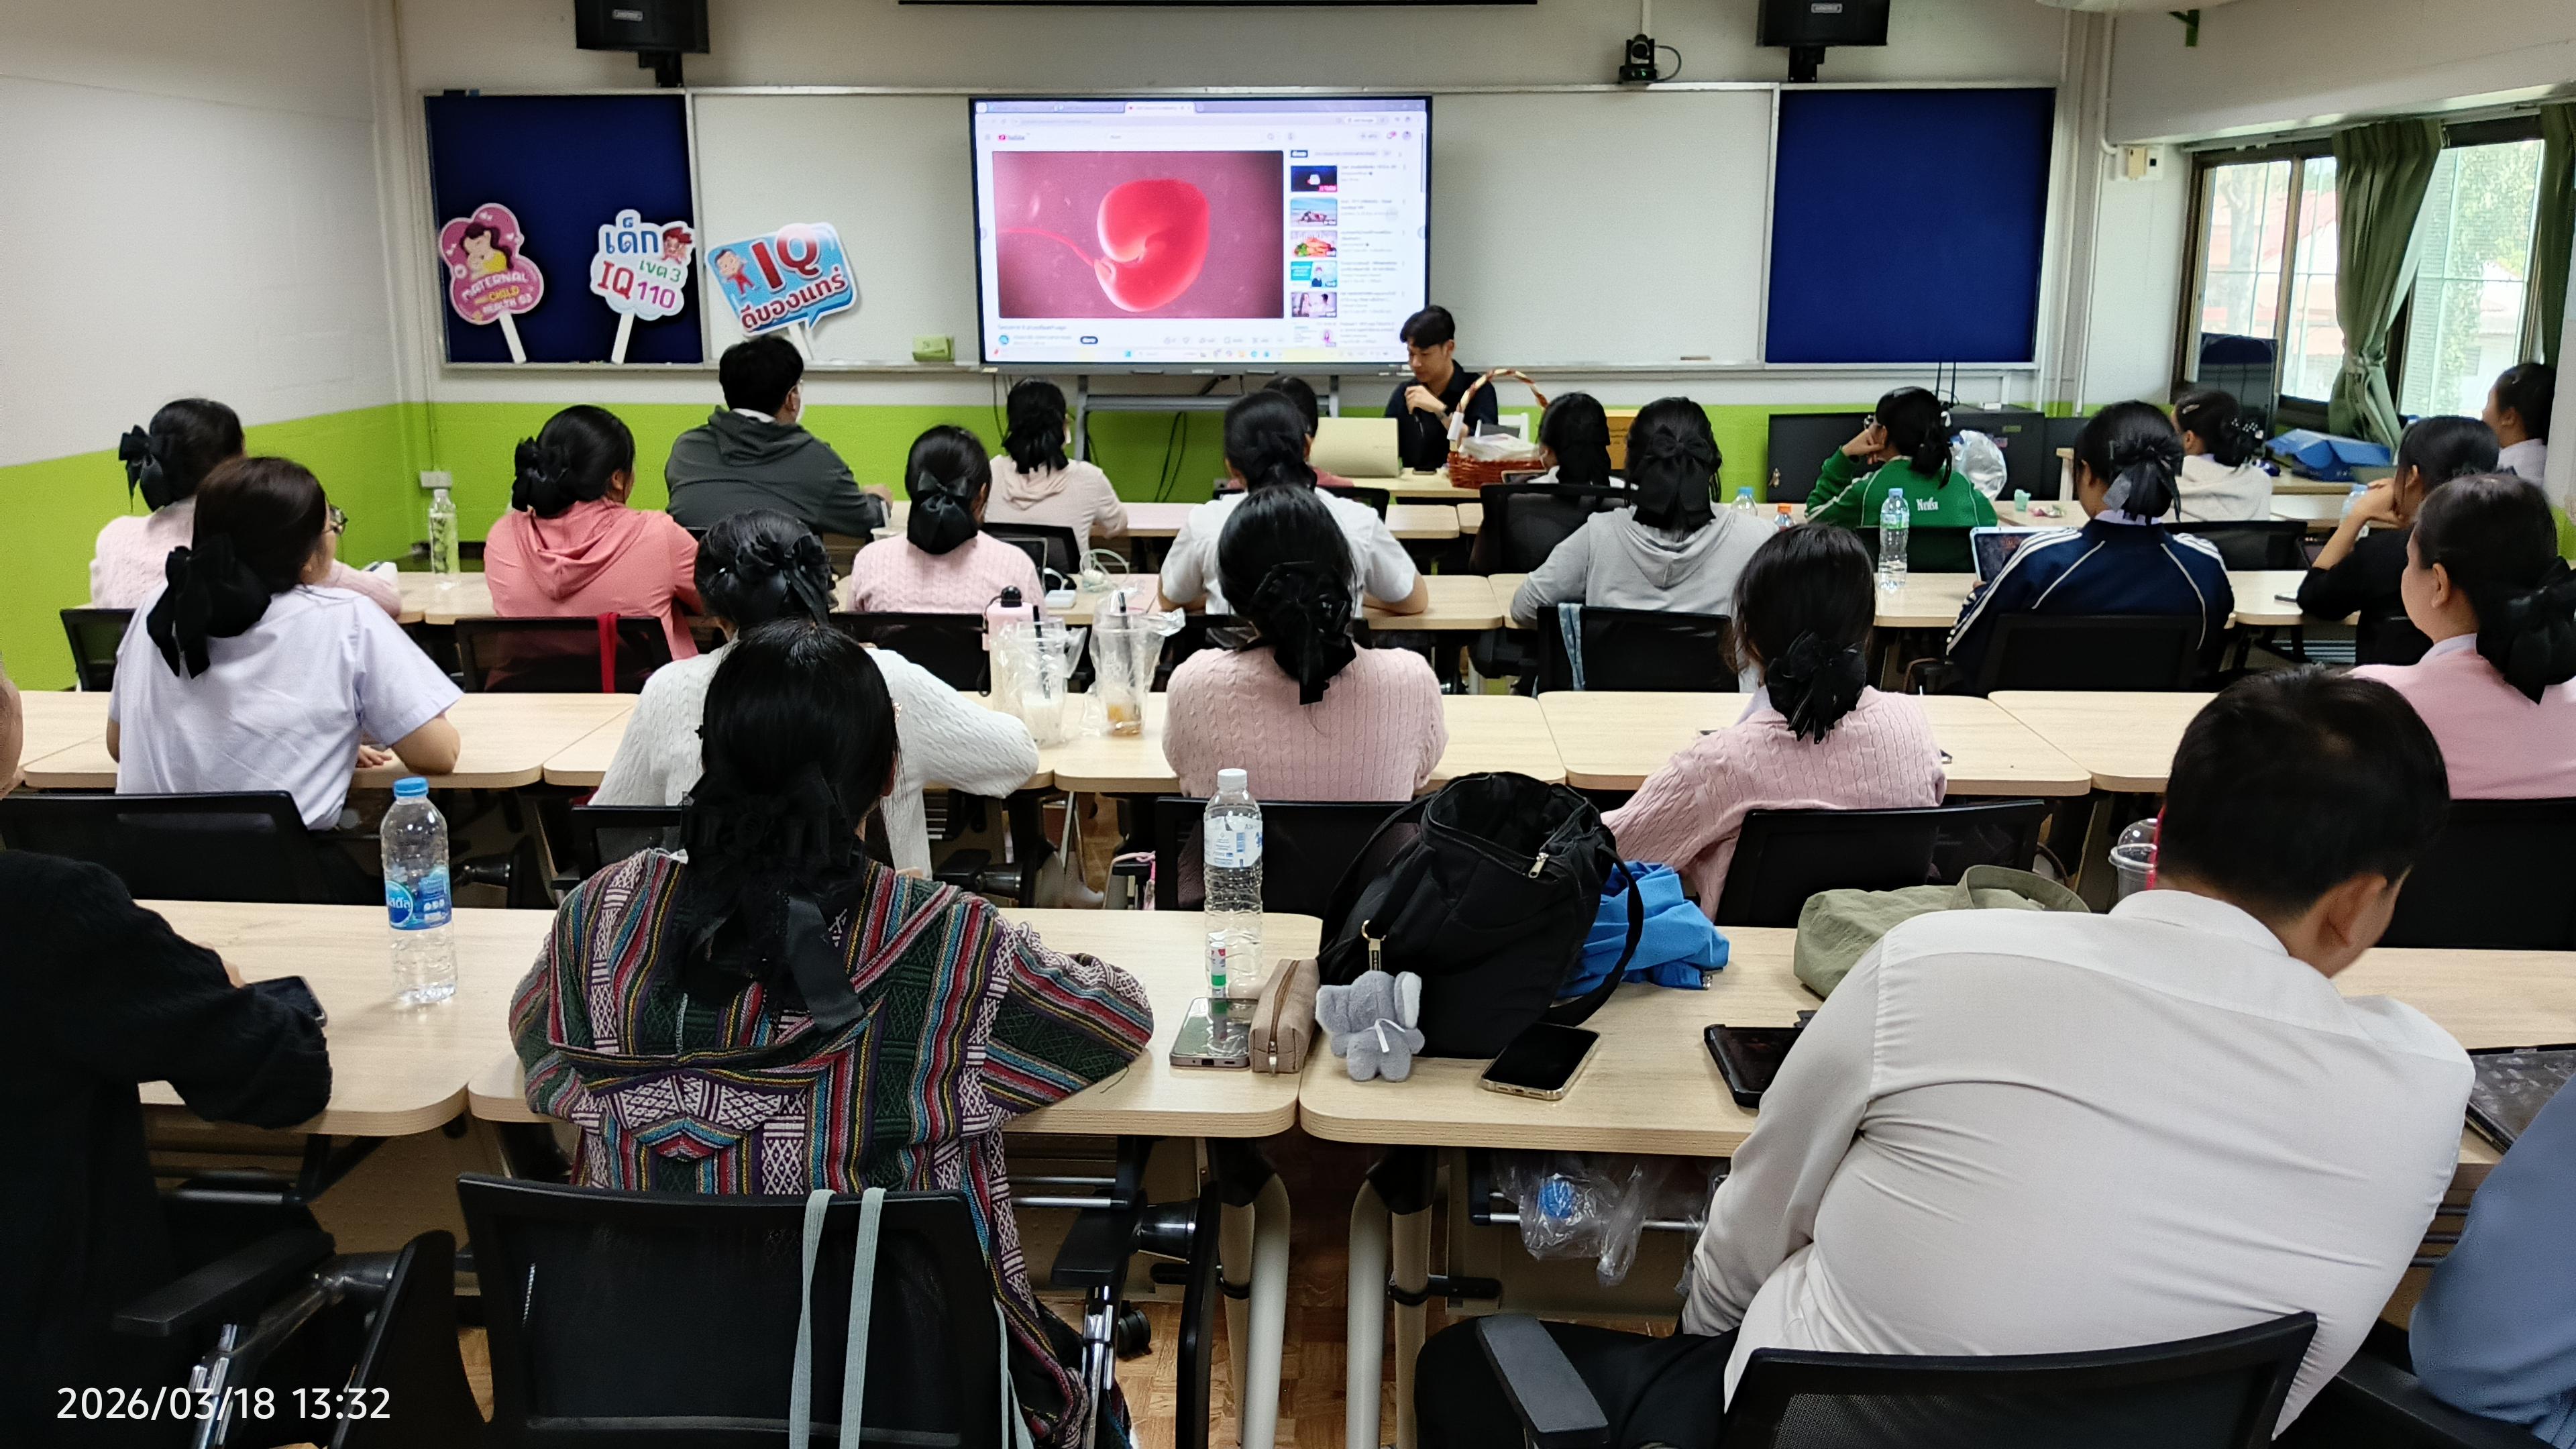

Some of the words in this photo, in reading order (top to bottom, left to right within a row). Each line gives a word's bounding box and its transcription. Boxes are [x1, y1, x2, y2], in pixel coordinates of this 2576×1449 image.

[605, 217, 659, 254] เด็ก
[639, 260, 668, 278] เขต
[669, 268, 682, 283] 3
[751, 225, 820, 290] IQ
[597, 260, 635, 300] IQ
[637, 280, 676, 309] 110
